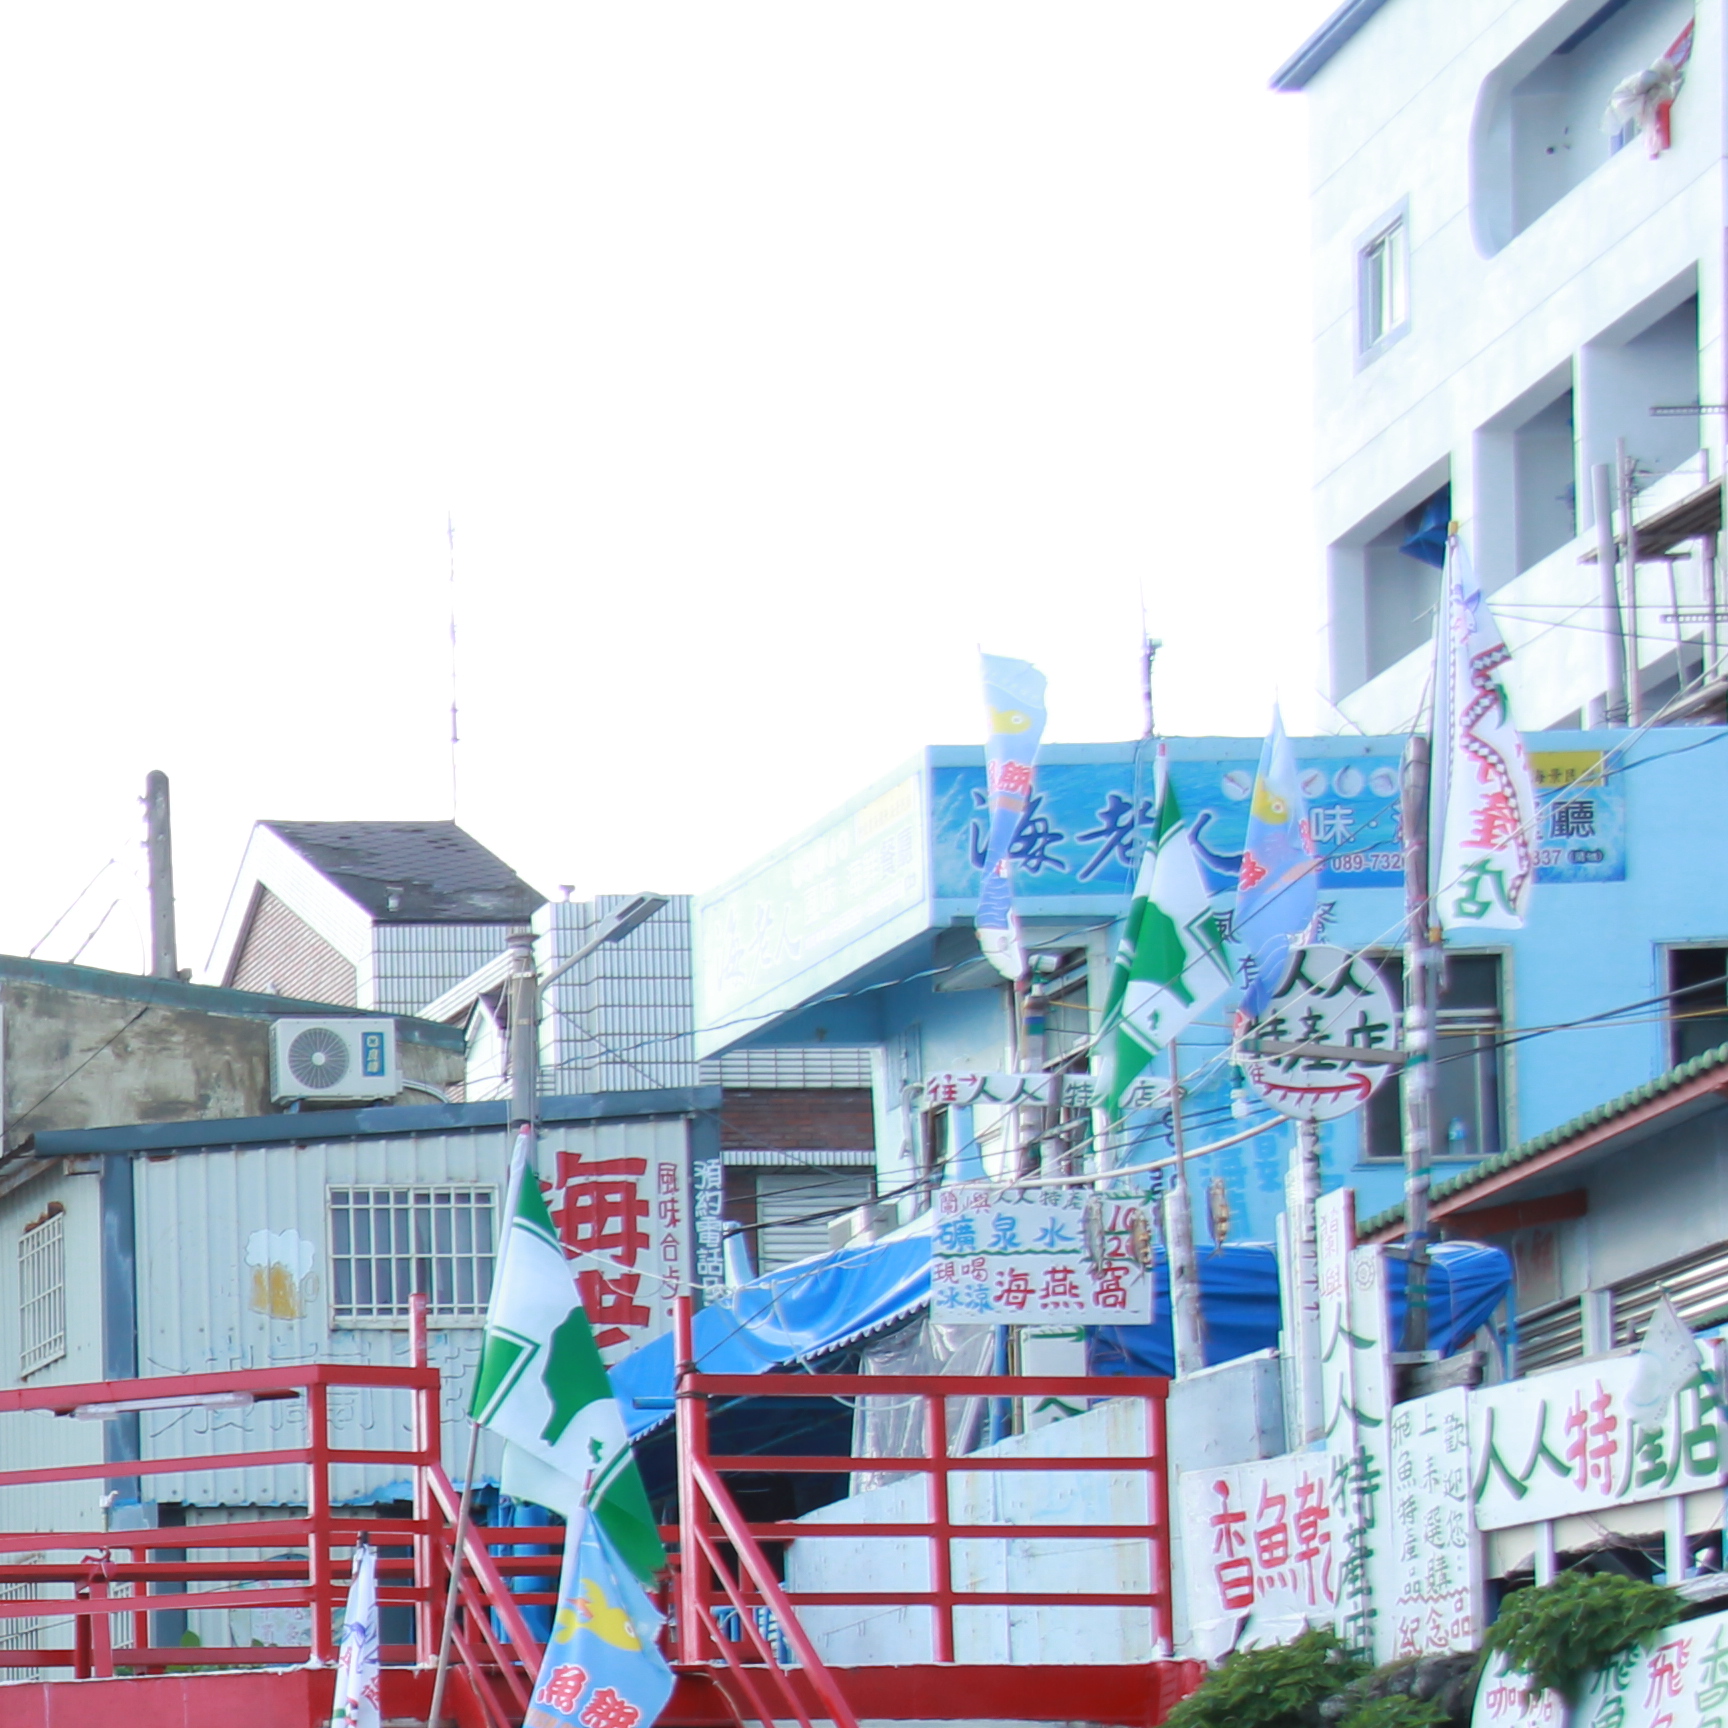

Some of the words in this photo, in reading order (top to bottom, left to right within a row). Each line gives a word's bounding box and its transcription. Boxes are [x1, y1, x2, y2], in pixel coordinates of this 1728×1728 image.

[967, 1076, 1159, 1108] 人人特店
[933, 1213, 1075, 1251] 礦泉水
